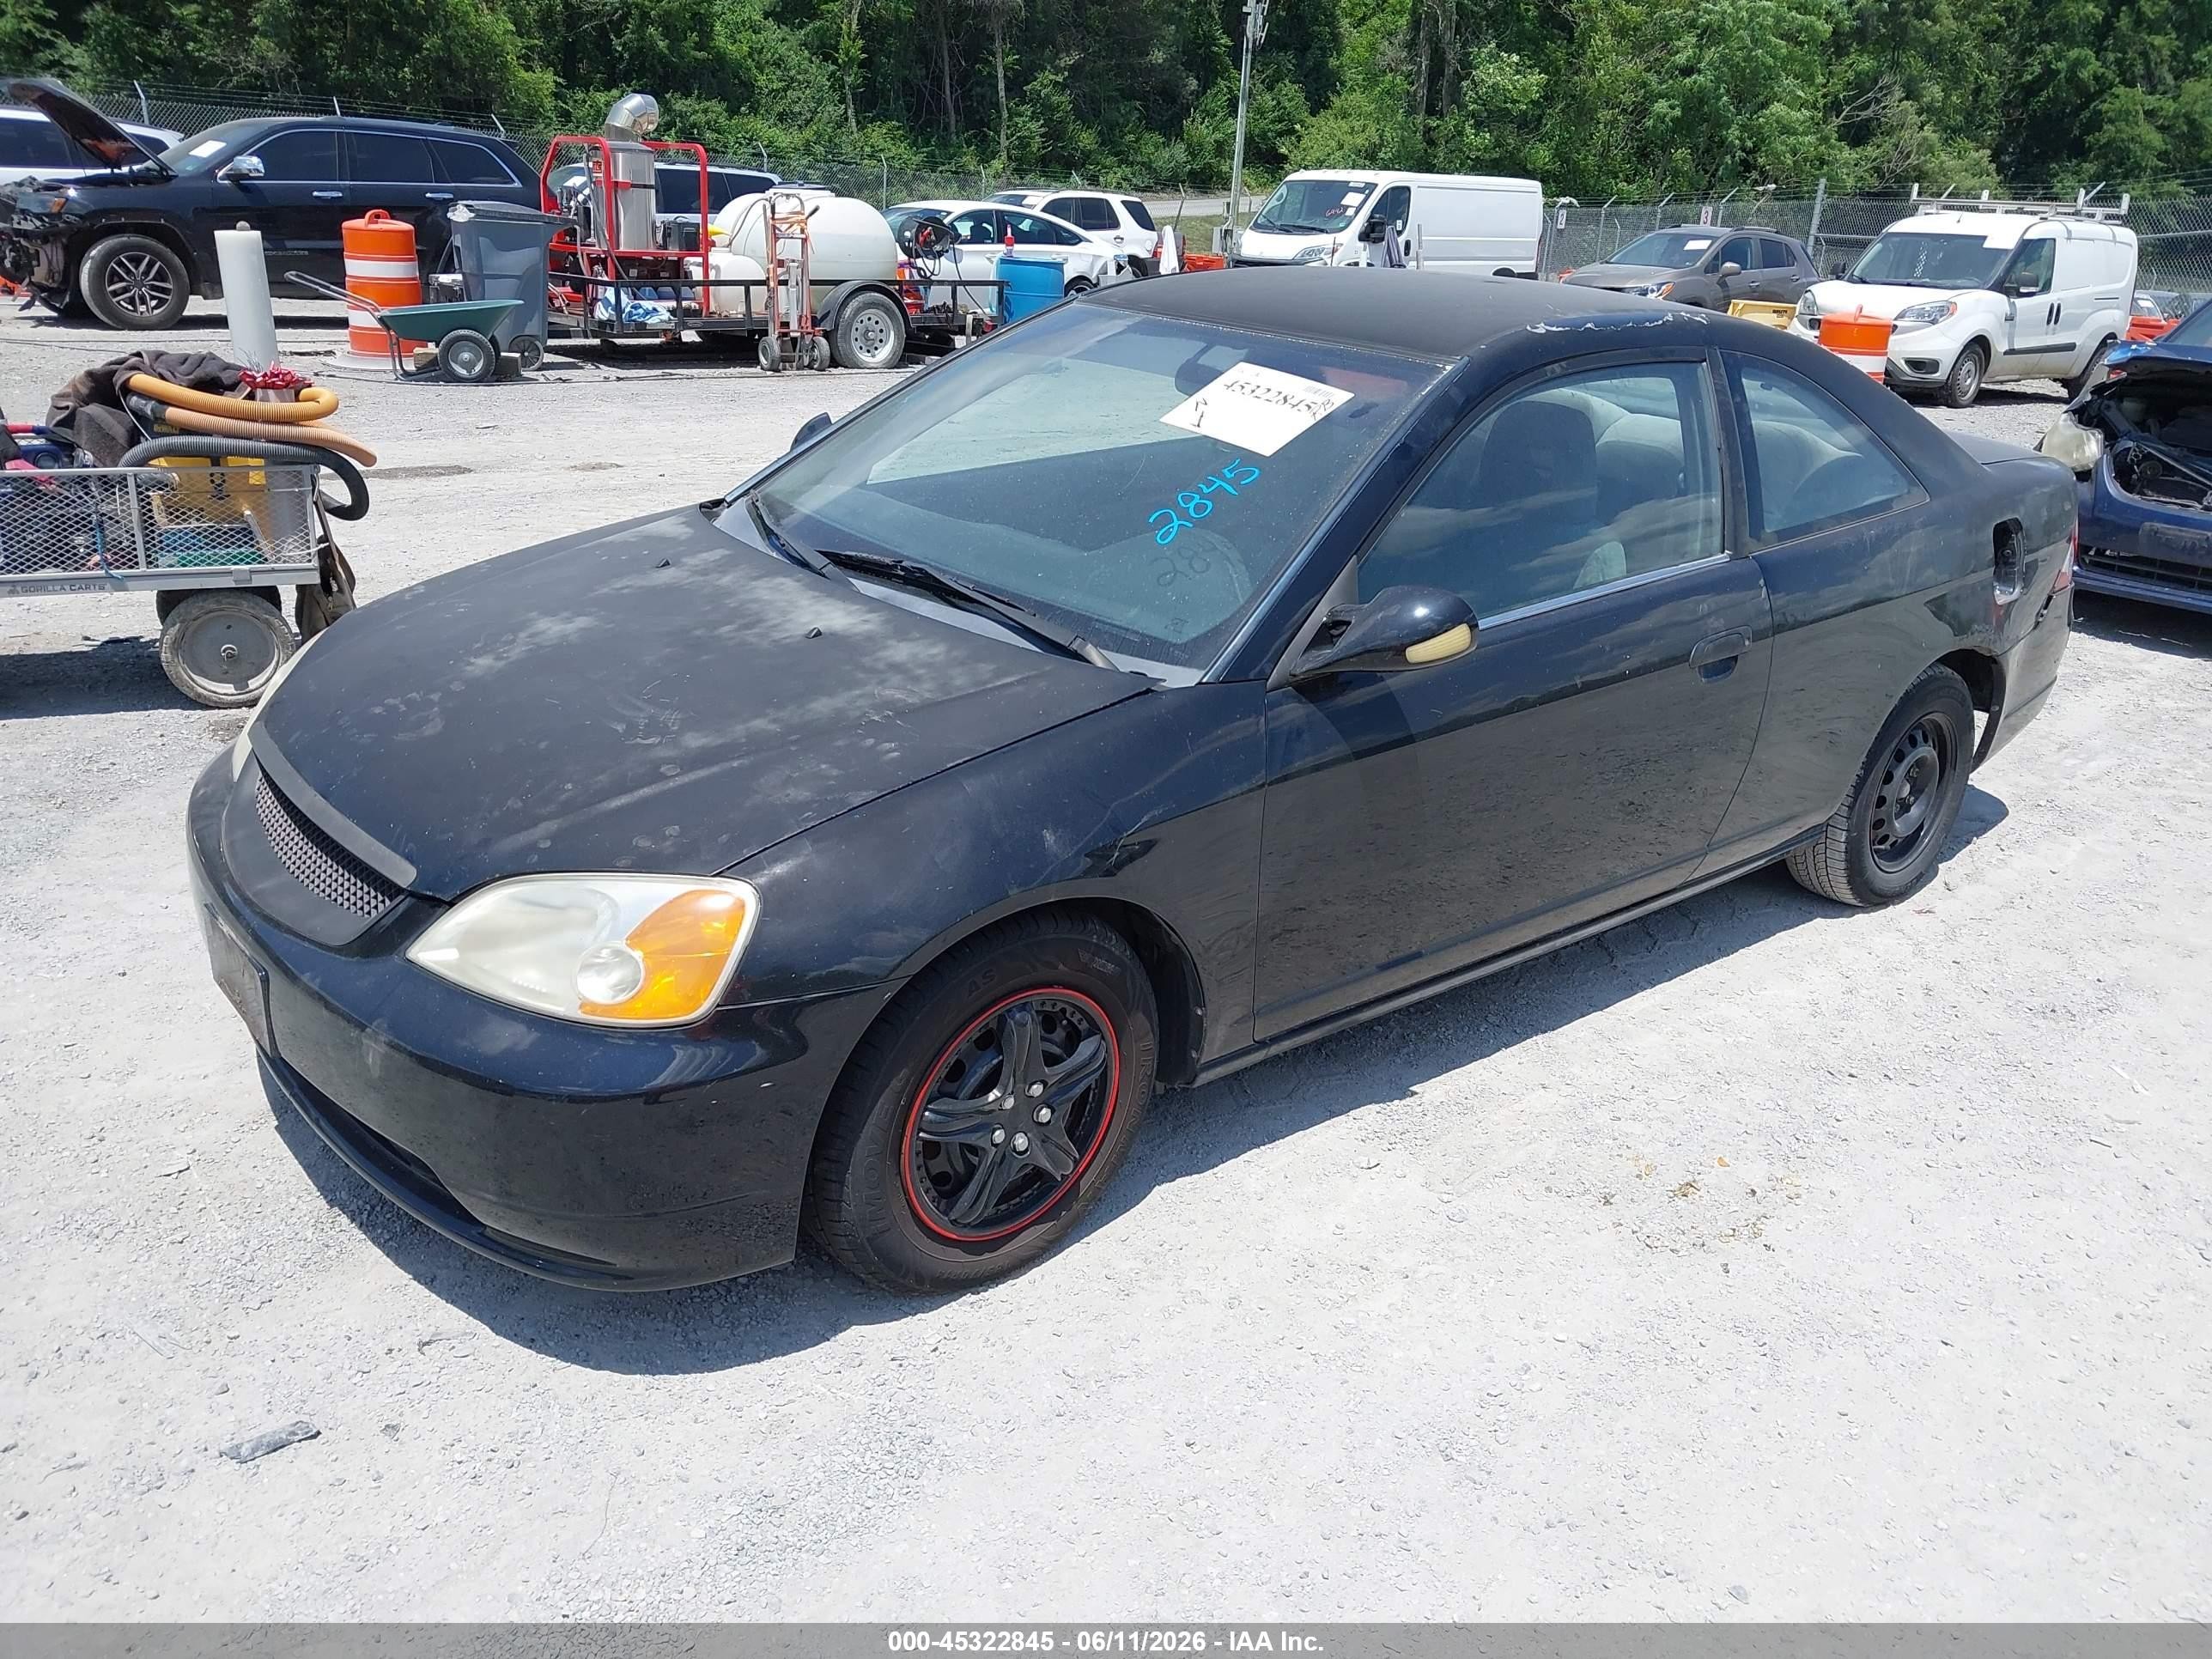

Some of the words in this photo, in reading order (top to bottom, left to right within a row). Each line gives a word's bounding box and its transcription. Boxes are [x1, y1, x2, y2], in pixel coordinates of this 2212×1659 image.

[1224, 380, 1318, 412] 45322845
[1148, 459, 1260, 545] 2845
[21, 584, 66, 593] GORILLA
[69, 583, 107, 592] CARTS
